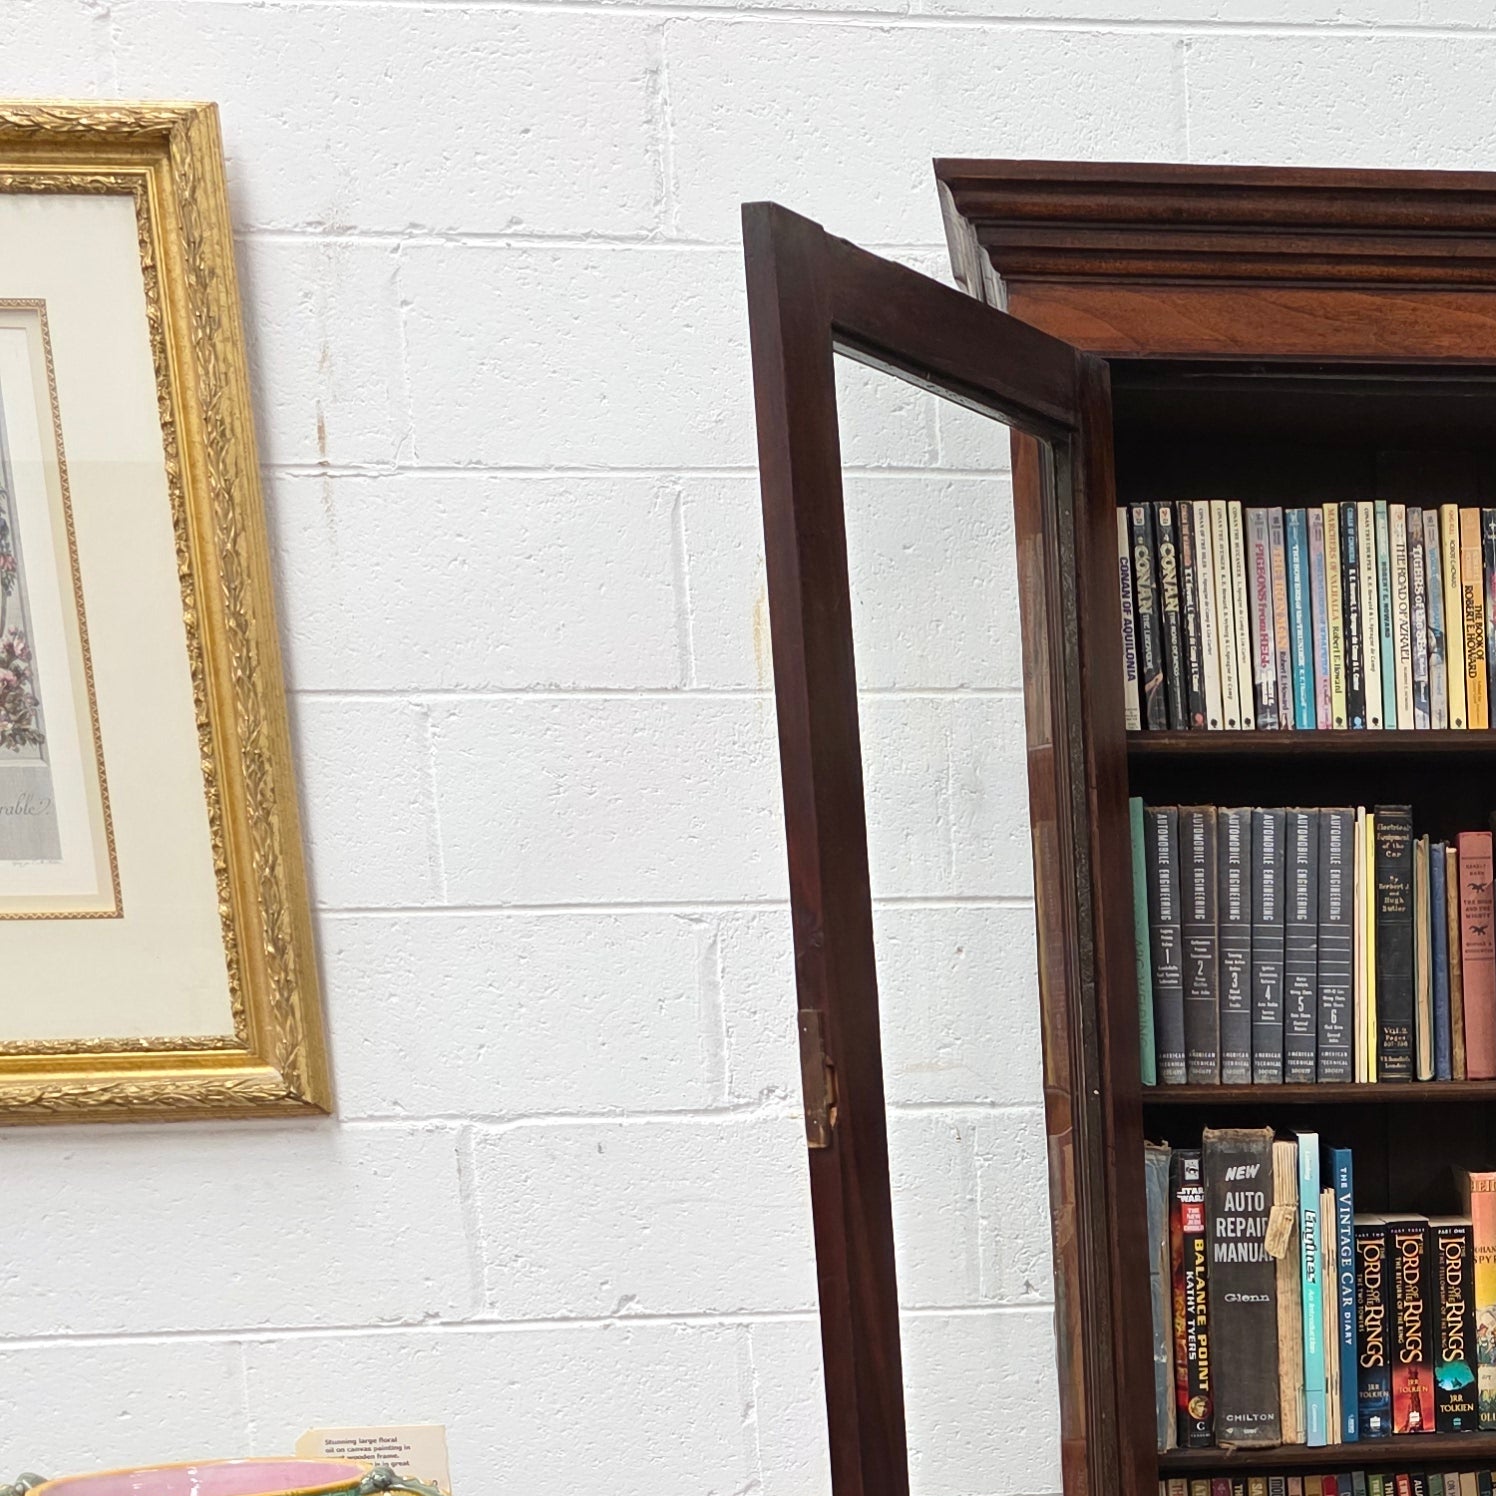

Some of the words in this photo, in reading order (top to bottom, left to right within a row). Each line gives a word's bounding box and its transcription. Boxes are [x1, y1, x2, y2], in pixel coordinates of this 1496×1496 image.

[1120, 557, 1132, 598] CONAN
[1134, 545, 1153, 615] CONAN
[1160, 542, 1179, 613] CONAN
[1255, 543, 1265, 600] PIGEONS
[1122, 601, 1132, 615] OF
[1258, 601, 1267, 632] from
[1464, 585, 1474, 623] ROBERT
[1123, 618, 1136, 681] AQUILONIA
[1260, 633, 1269, 668] HELL
[1475, 622, 1483, 648] BOOK
[1476, 650, 1484, 660] OF
[1157, 814, 1170, 864] AUTOMOBILE
[1193, 813, 1204, 863] AUTOMOBILE
[1229, 815, 1240, 864] AUTOMOBILE
[1263, 814, 1274, 864] AUTOMOBILE
[1297, 814, 1308, 864] AUTOMOBILE
[1330, 815, 1341, 864] AUTOMOBILE
[1159, 870, 1171, 921] ENGINEERING
[1194, 868, 1206, 919] ENGINEERING
[1229, 869, 1240, 920] ENGINEERING
[1263, 870, 1273, 921] ENGINEERING
[1297, 869, 1308, 920] ENGINEERING
[1330, 870, 1341, 920] ENGINEERING
[1165, 948, 1170, 964] 1
[1198, 960, 1204, 975] 2
[1231, 972, 1238, 988] 3
[1265, 985, 1271, 1000] 4
[1298, 997, 1304, 1012] 5
[1331, 1009, 1337, 1024] 6
[1225, 1163, 1261, 1182] NEW
[1339, 1167, 1348, 1188] THE
[1224, 1191, 1266, 1213] AUTO
[1339, 1193, 1352, 1267] VINTAGE
[1194, 1239, 1207, 1326] BALANCE
[1356, 1238, 1385, 1289] LORD
[1395, 1234, 1424, 1284] LORD
[1438, 1236, 1466, 1286] LORD
[1185, 1271, 1196, 1316] KATHY
[1224, 1293, 1271, 1303] Glenn
[1342, 1272, 1354, 1307] CAR
[1396, 1301, 1403, 1310] OF
[1188, 1320, 1197, 1360] TYERS
[1344, 1312, 1352, 1345] DIARY
[1359, 1305, 1384, 1368] RINGS
[1399, 1300, 1423, 1364] RINGS
[1442, 1302, 1465, 1362] RINGS
[1198, 1334, 1209, 1391] POINT
[1226, 1413, 1275, 1422] CHILTON
[373, 1444, 402, 1452] painting
